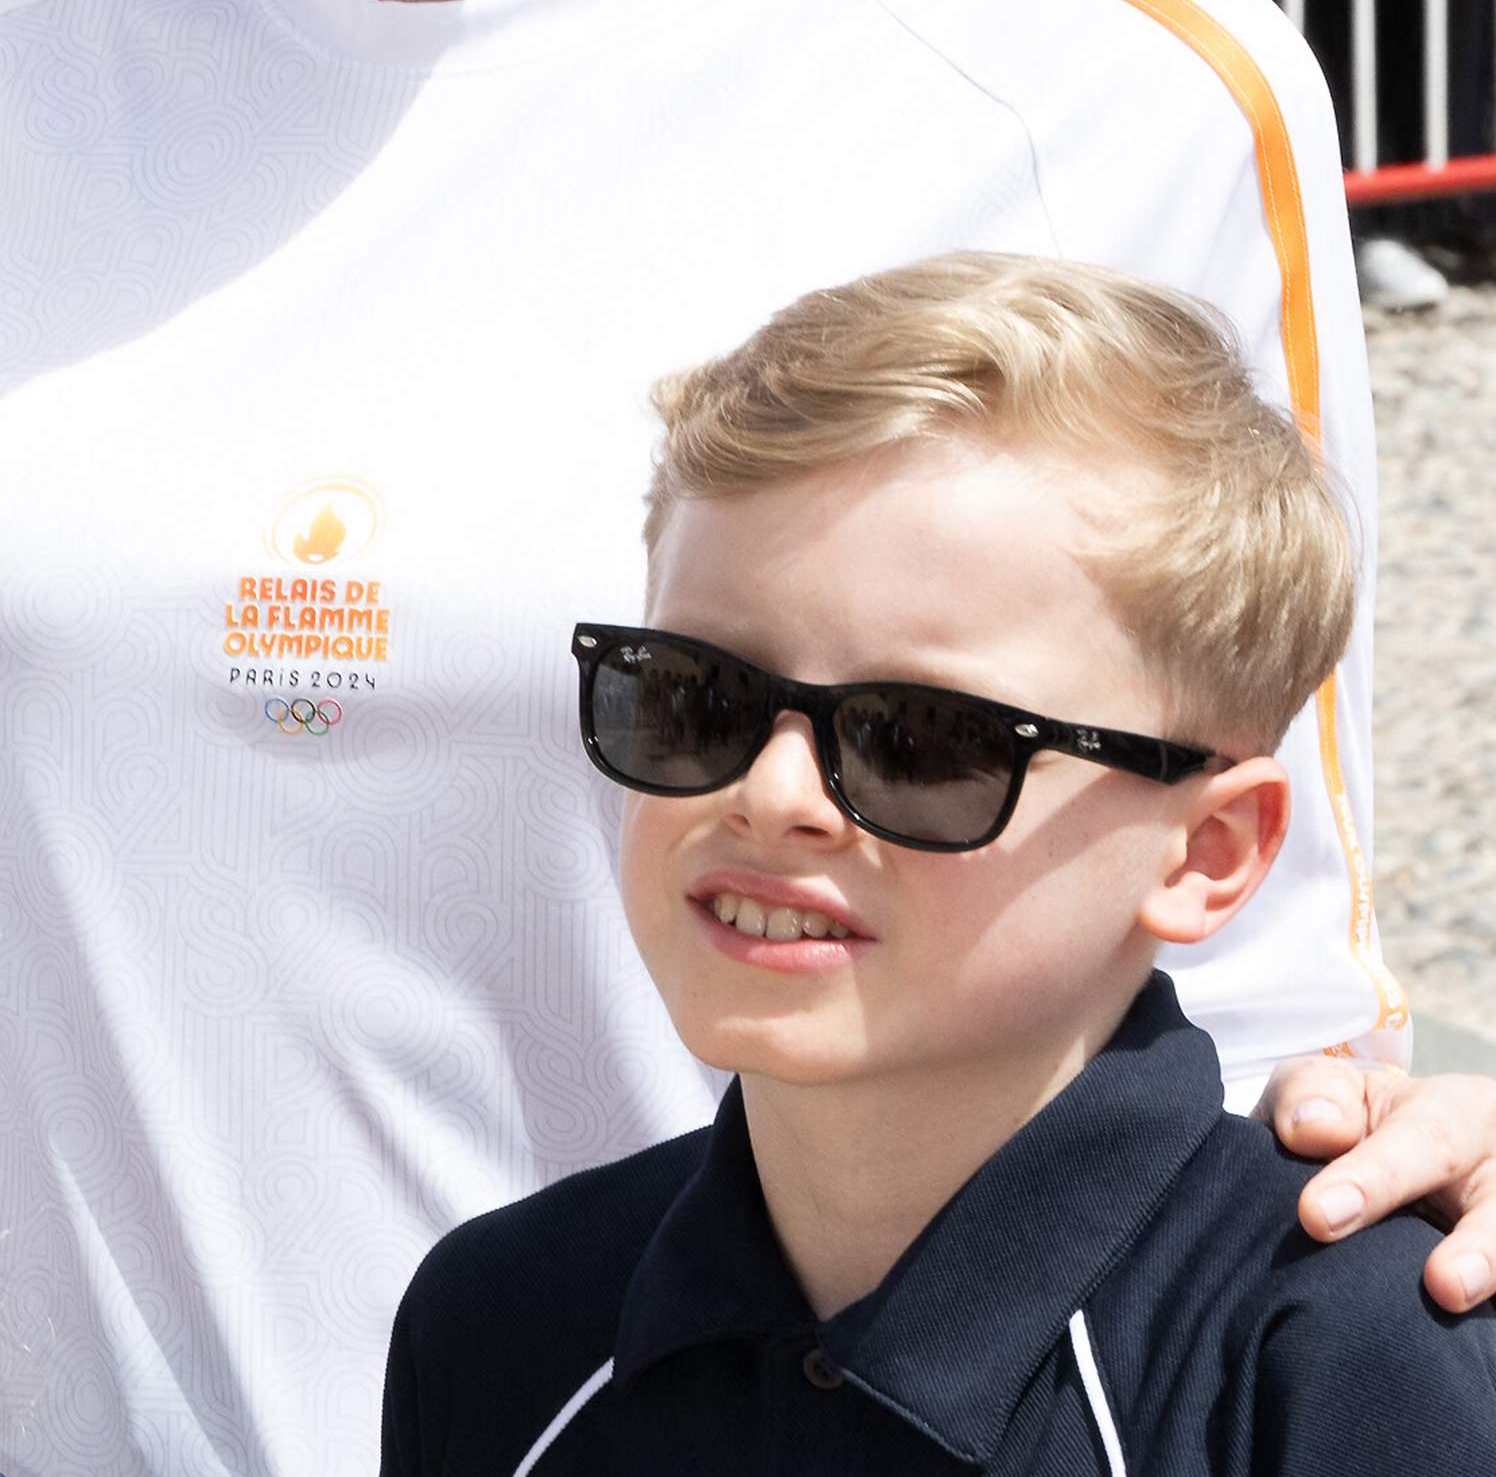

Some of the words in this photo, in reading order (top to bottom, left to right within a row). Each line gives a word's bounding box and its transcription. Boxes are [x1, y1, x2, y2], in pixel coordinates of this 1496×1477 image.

[239, 576, 338, 604] RELAIS
[345, 580, 381, 605] DE
[225, 604, 260, 629] LA
[267, 605, 391, 633] FLAMME
[223, 632, 389, 662] OLYMPIQUE
[311, 670, 377, 691] 2024
